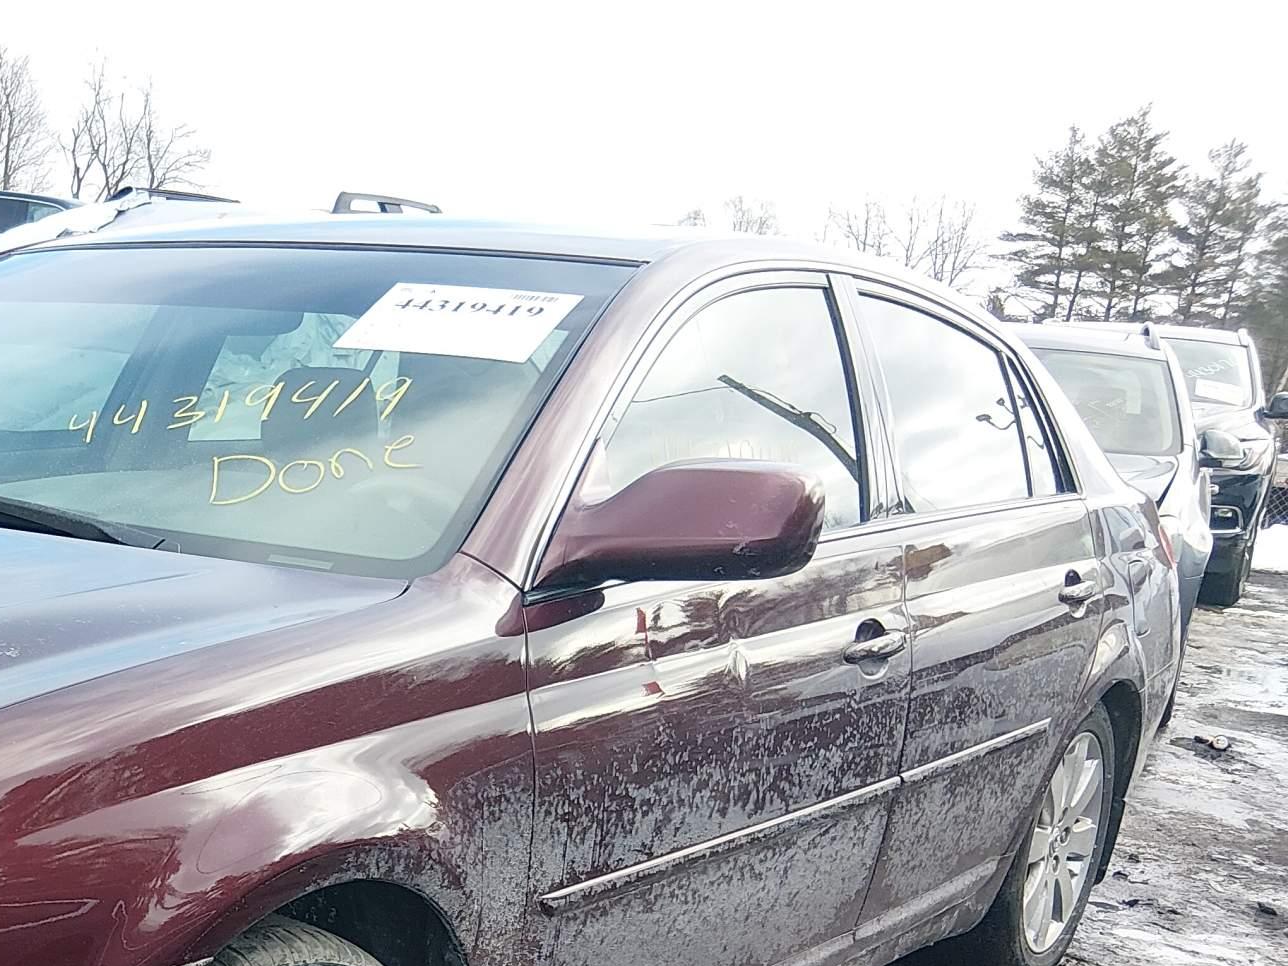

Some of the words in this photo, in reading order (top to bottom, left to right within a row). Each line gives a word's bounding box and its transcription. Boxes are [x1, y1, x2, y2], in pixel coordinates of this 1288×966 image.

[395, 298, 545, 318] 44319419
[68, 376, 414, 443] 44319419
[209, 434, 423, 505] Done
